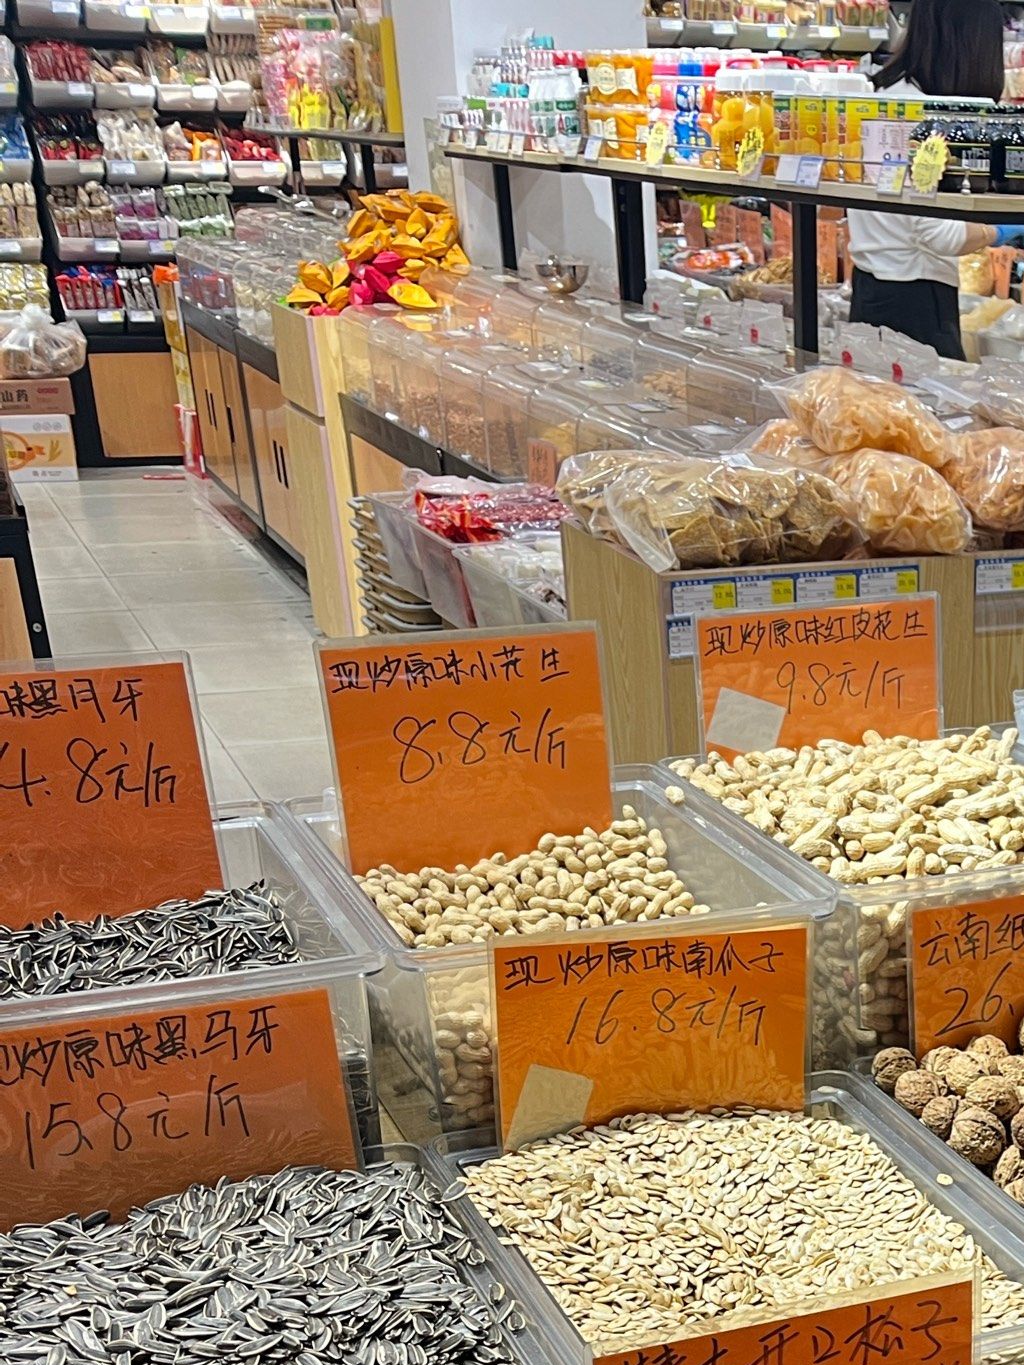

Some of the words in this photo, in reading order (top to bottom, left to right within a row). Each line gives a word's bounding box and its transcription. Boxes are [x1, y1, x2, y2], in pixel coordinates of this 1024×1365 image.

[704, 607, 928, 656] 现炒原味红皮花生
[328, 645, 570, 693] 现炒原味小花生
[776, 661, 905, 714] 9.8元/斤
[504, 936, 783, 991] 现炒原味南瓜子
[566, 985, 766, 1047] 16.8元/斤
[25, 1074, 250, 1170] 15.8元/斤
